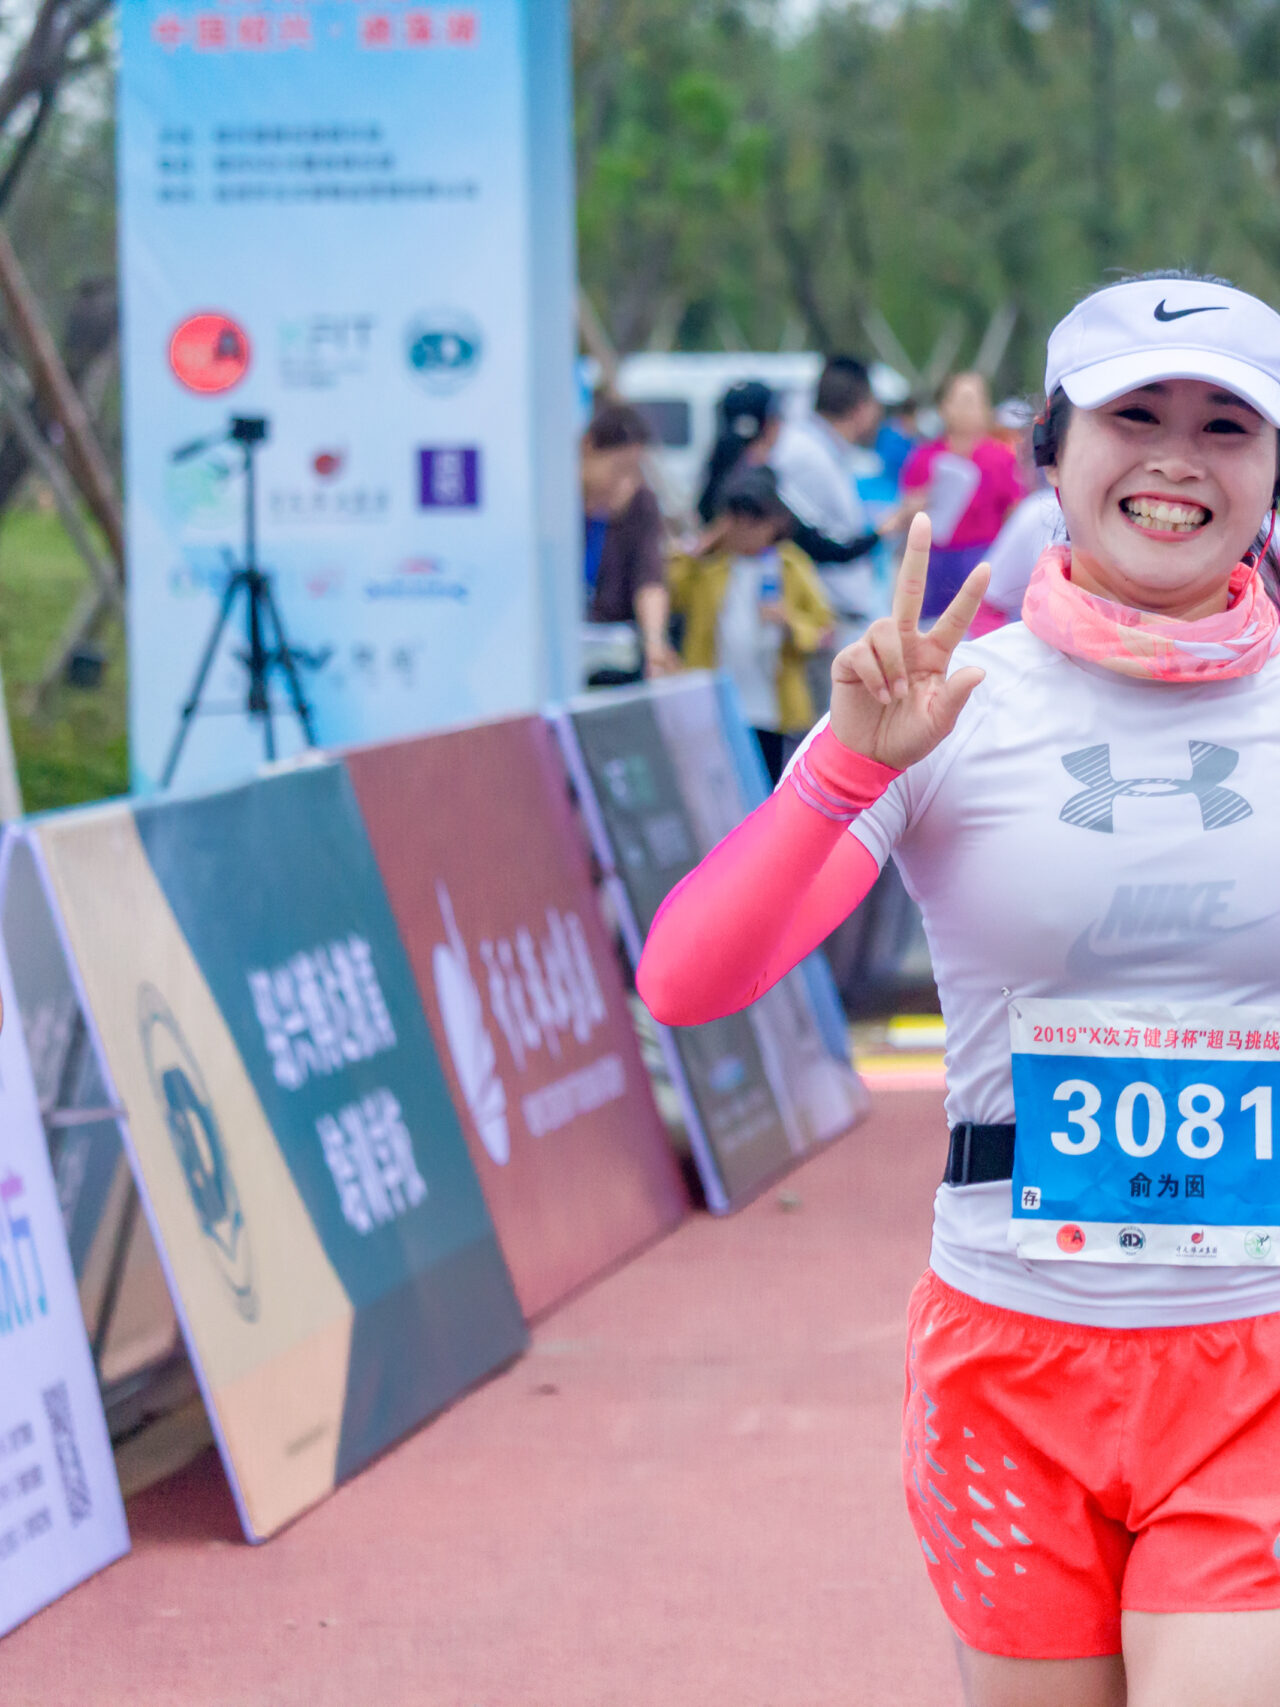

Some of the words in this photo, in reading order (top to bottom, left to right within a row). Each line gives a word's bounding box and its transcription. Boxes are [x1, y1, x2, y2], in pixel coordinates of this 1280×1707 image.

[1097, 880, 1236, 939] NIKE
[1050, 1079, 1273, 1160] 3081
[1023, 1190, 1039, 1207] 存
